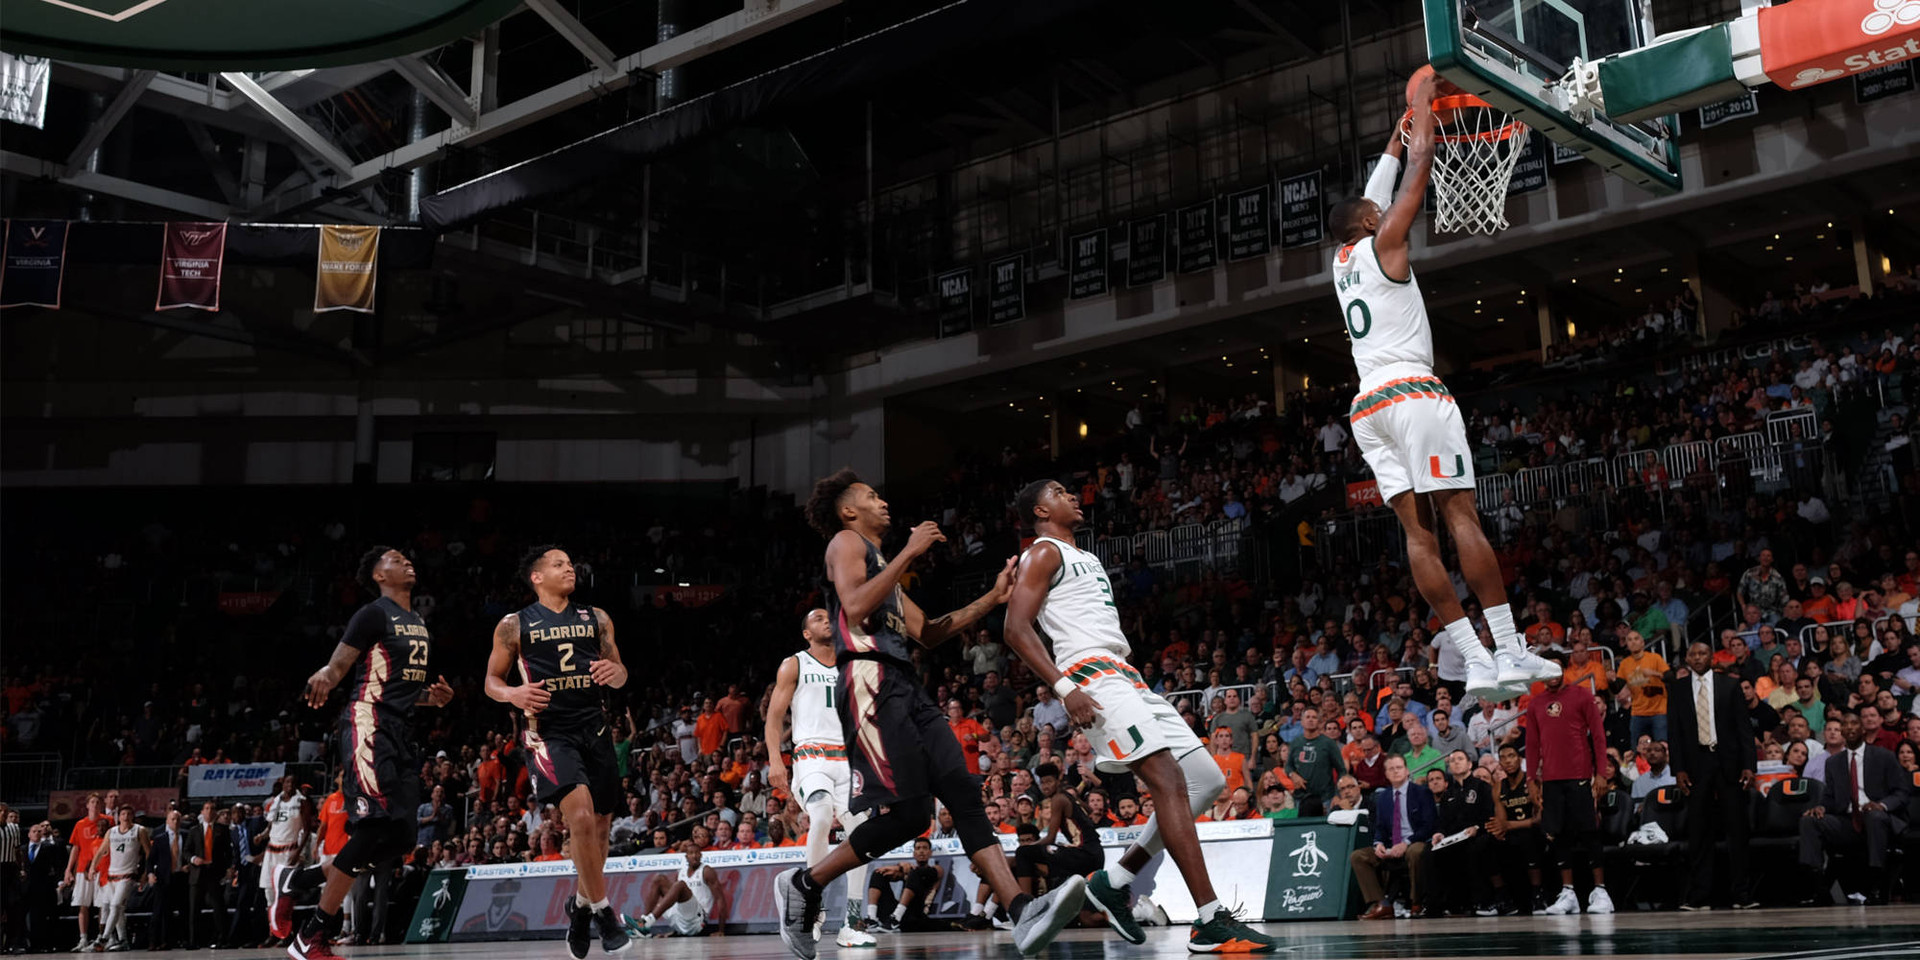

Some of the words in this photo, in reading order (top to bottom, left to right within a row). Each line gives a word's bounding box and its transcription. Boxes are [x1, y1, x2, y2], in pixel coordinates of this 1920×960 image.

[1843, 37, 1920, 72] Stat
[1283, 178, 1318, 205] NCAA
[1238, 194, 1260, 216] NIT
[1079, 235, 1098, 258] NIT
[15, 258, 52, 267] VIRGINIA
[173, 260, 210, 269] VIRGINIA
[321, 262, 343, 271] WAKE
[180, 268, 202, 277] TECH
[997, 262, 1015, 285] NIT
[941, 274, 969, 298] NCAA
[1346, 298, 1372, 339] 0
[1357, 487, 1377, 500] 122
[529, 624, 596, 644] FLORIDA
[408, 639, 429, 667] 23
[557, 642, 577, 673] 2
[545, 674, 592, 693] STATE
[203, 767, 271, 781] RAYCOM
[116, 842, 126, 854] 4
[759, 850, 806, 860] EASTERN
[529, 862, 569, 873] EASTERN
[639, 859, 682, 868] EASTERN
[477, 867, 516, 877] EASTERN
